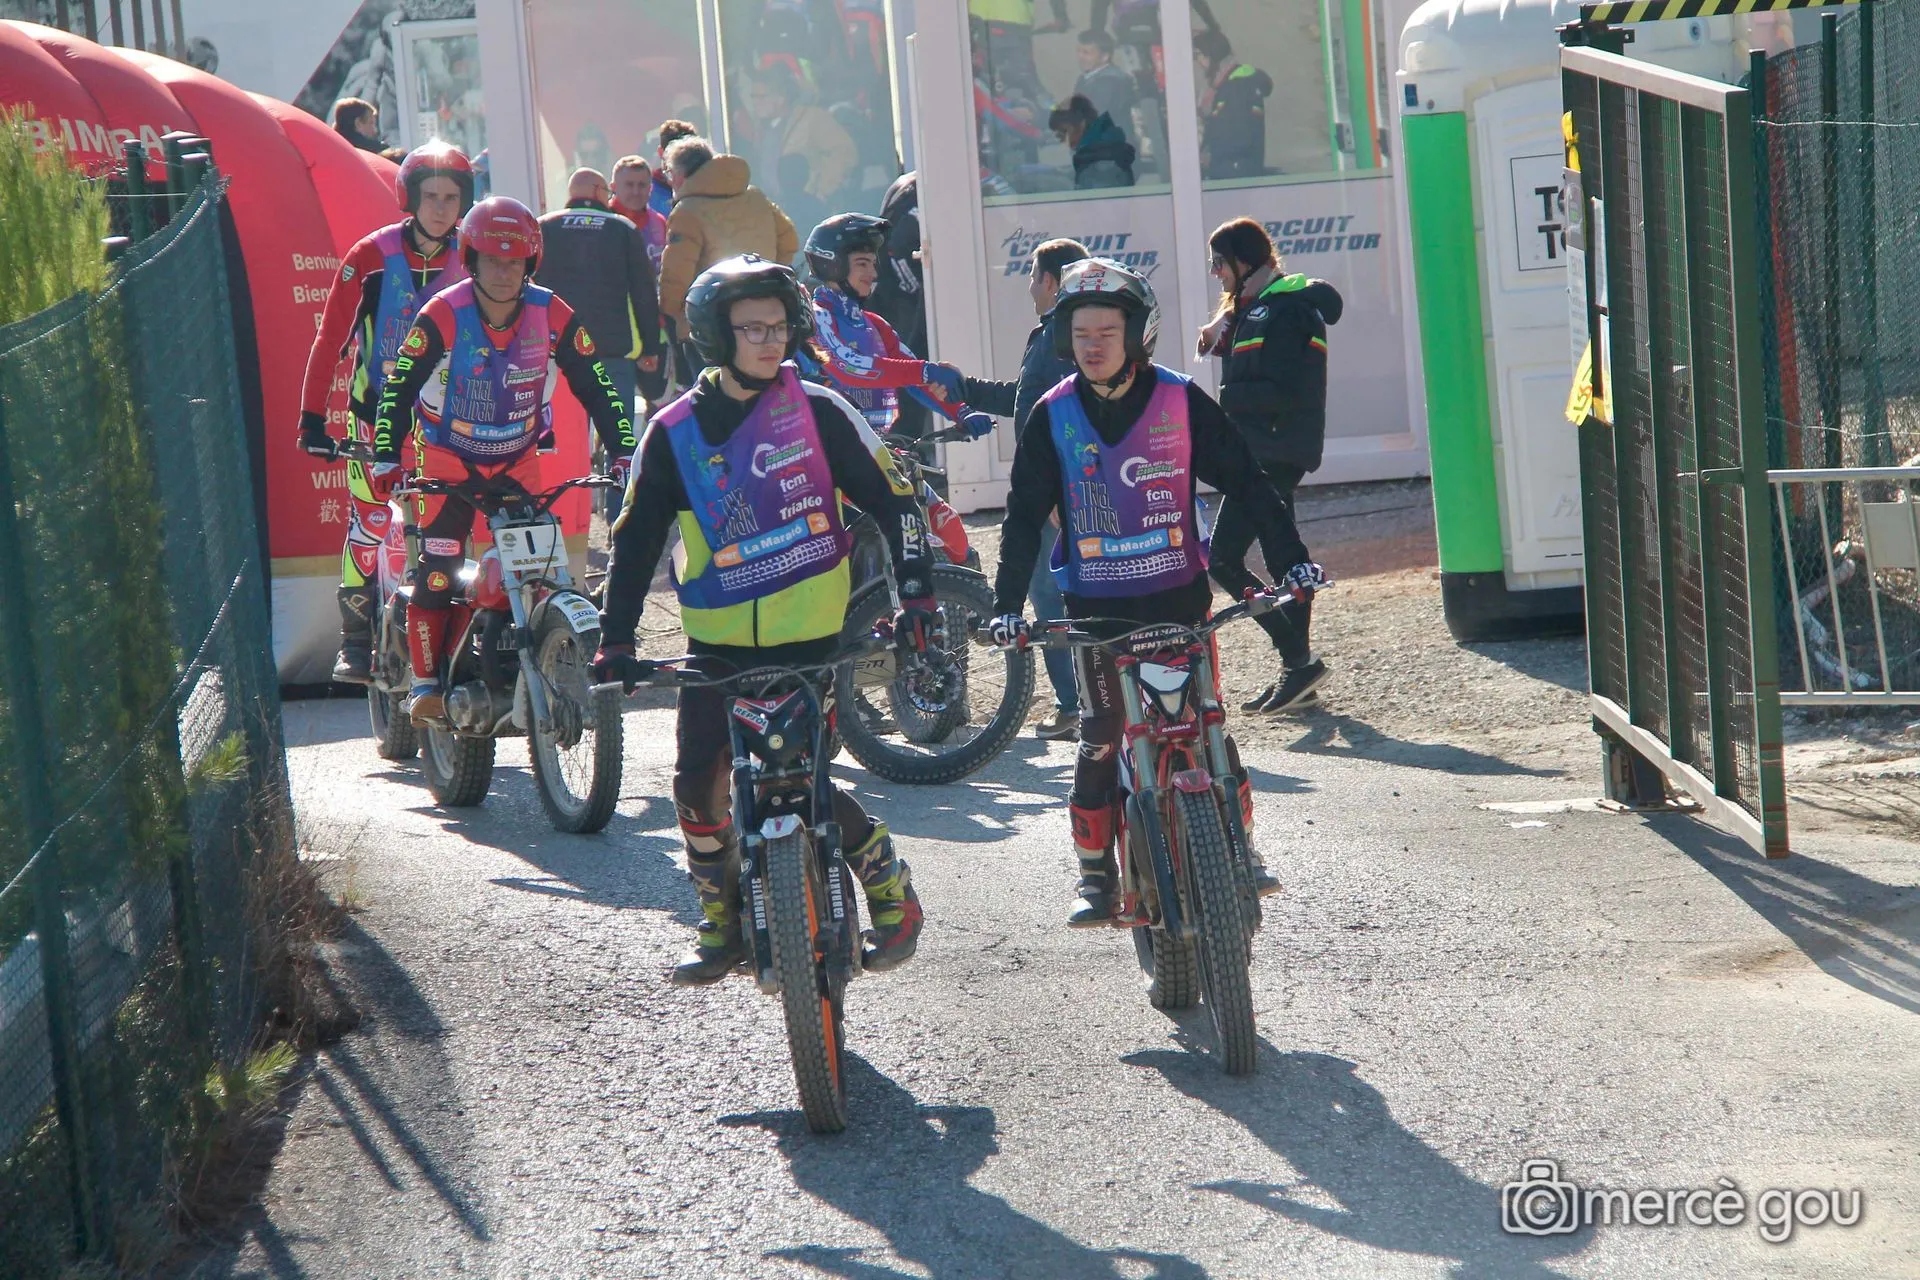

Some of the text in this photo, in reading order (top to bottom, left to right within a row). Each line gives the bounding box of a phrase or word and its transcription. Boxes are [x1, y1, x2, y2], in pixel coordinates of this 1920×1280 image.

[1262, 215, 1354, 237] RCUIT
[1279, 231, 1381, 255] CMOTOR
[292, 253, 342, 271] Benvin
[293, 286, 330, 304] Bien
[514, 390, 535, 402] fcm
[312, 472, 350, 489] Will
[780, 473, 807, 493] fcm
[1146, 489, 1173, 502] fcm
[901, 513, 919, 561] TRS
[1105, 543, 1118, 553] La
[1120, 534, 1163, 553] Marató
[743, 542, 760, 555] La
[418, 620, 434, 672] alpinestars
[1096, 673, 1112, 708] TEAM
[734, 708, 768, 727] REPSOL
